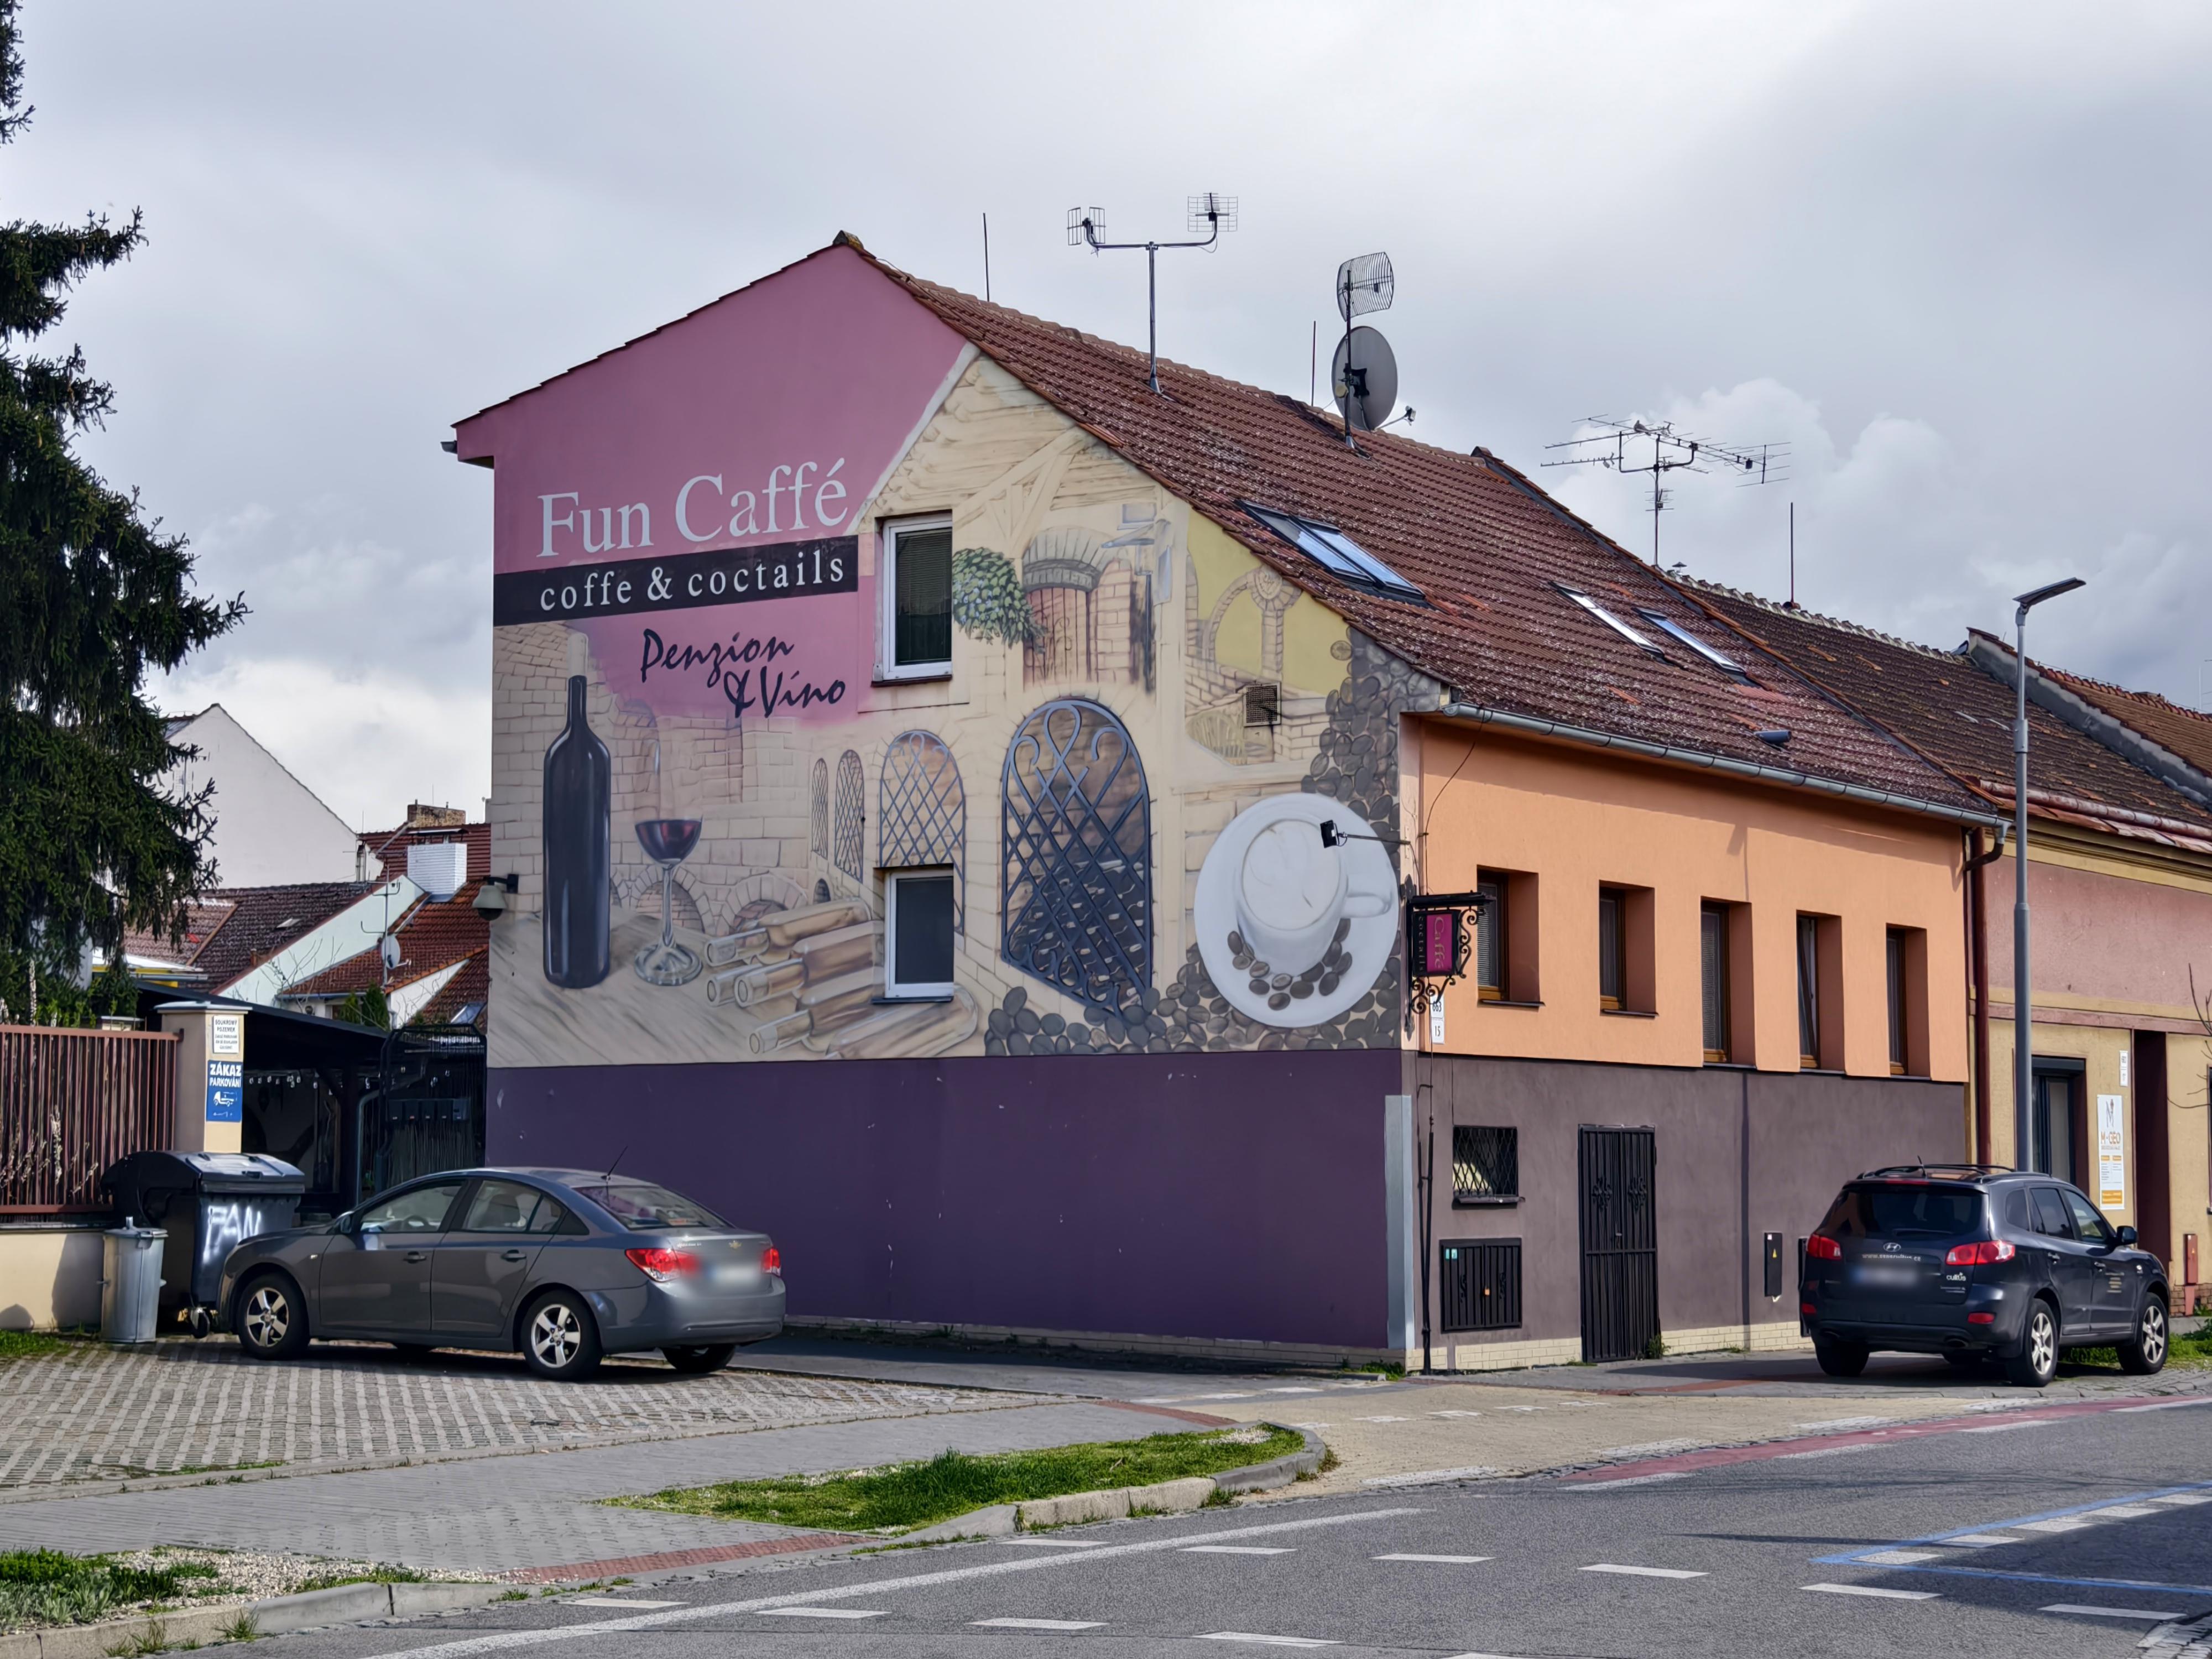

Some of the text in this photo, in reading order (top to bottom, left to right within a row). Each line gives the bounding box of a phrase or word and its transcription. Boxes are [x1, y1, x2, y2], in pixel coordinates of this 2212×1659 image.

[536, 458, 848, 557] Fun Caffé
[540, 550, 844, 611] coffe & coctails
[640, 628, 794, 687] Penzion
[1435, 1025, 1441, 1037] 15
[209, 1077, 241, 1088] PARKOVÁNÍ
[210, 1061, 242, 1077] ZÁKAZ
